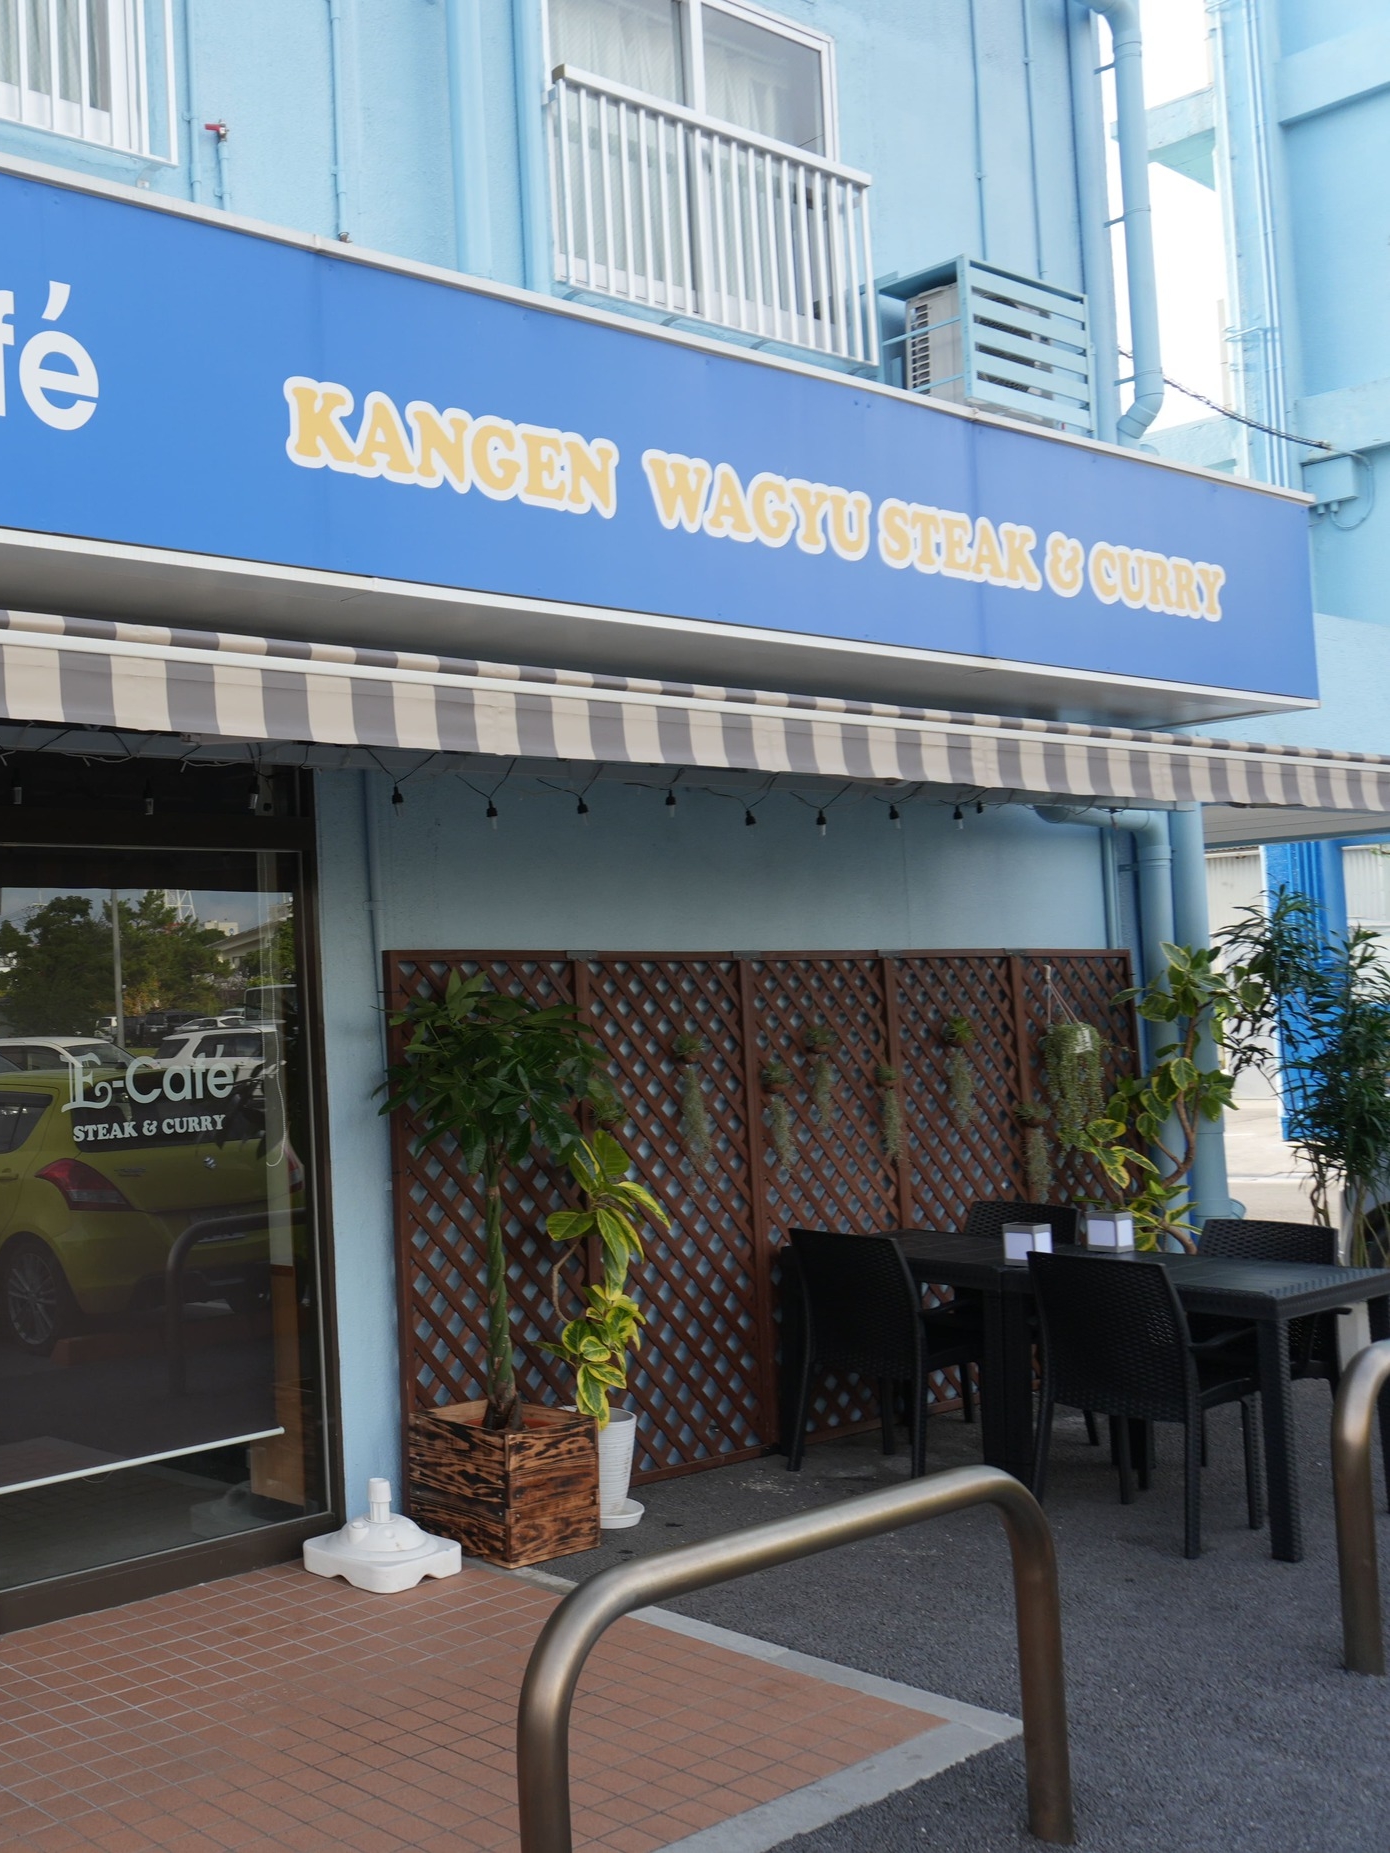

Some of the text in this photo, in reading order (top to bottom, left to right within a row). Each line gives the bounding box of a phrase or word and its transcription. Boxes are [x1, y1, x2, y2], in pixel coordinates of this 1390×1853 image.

[283, 376, 1226, 622] KANGEN WAGYU STEAK & CURRY
[60, 1044, 234, 1113] E-Café
[73, 1114, 226, 1142] STEAK & CURRY
